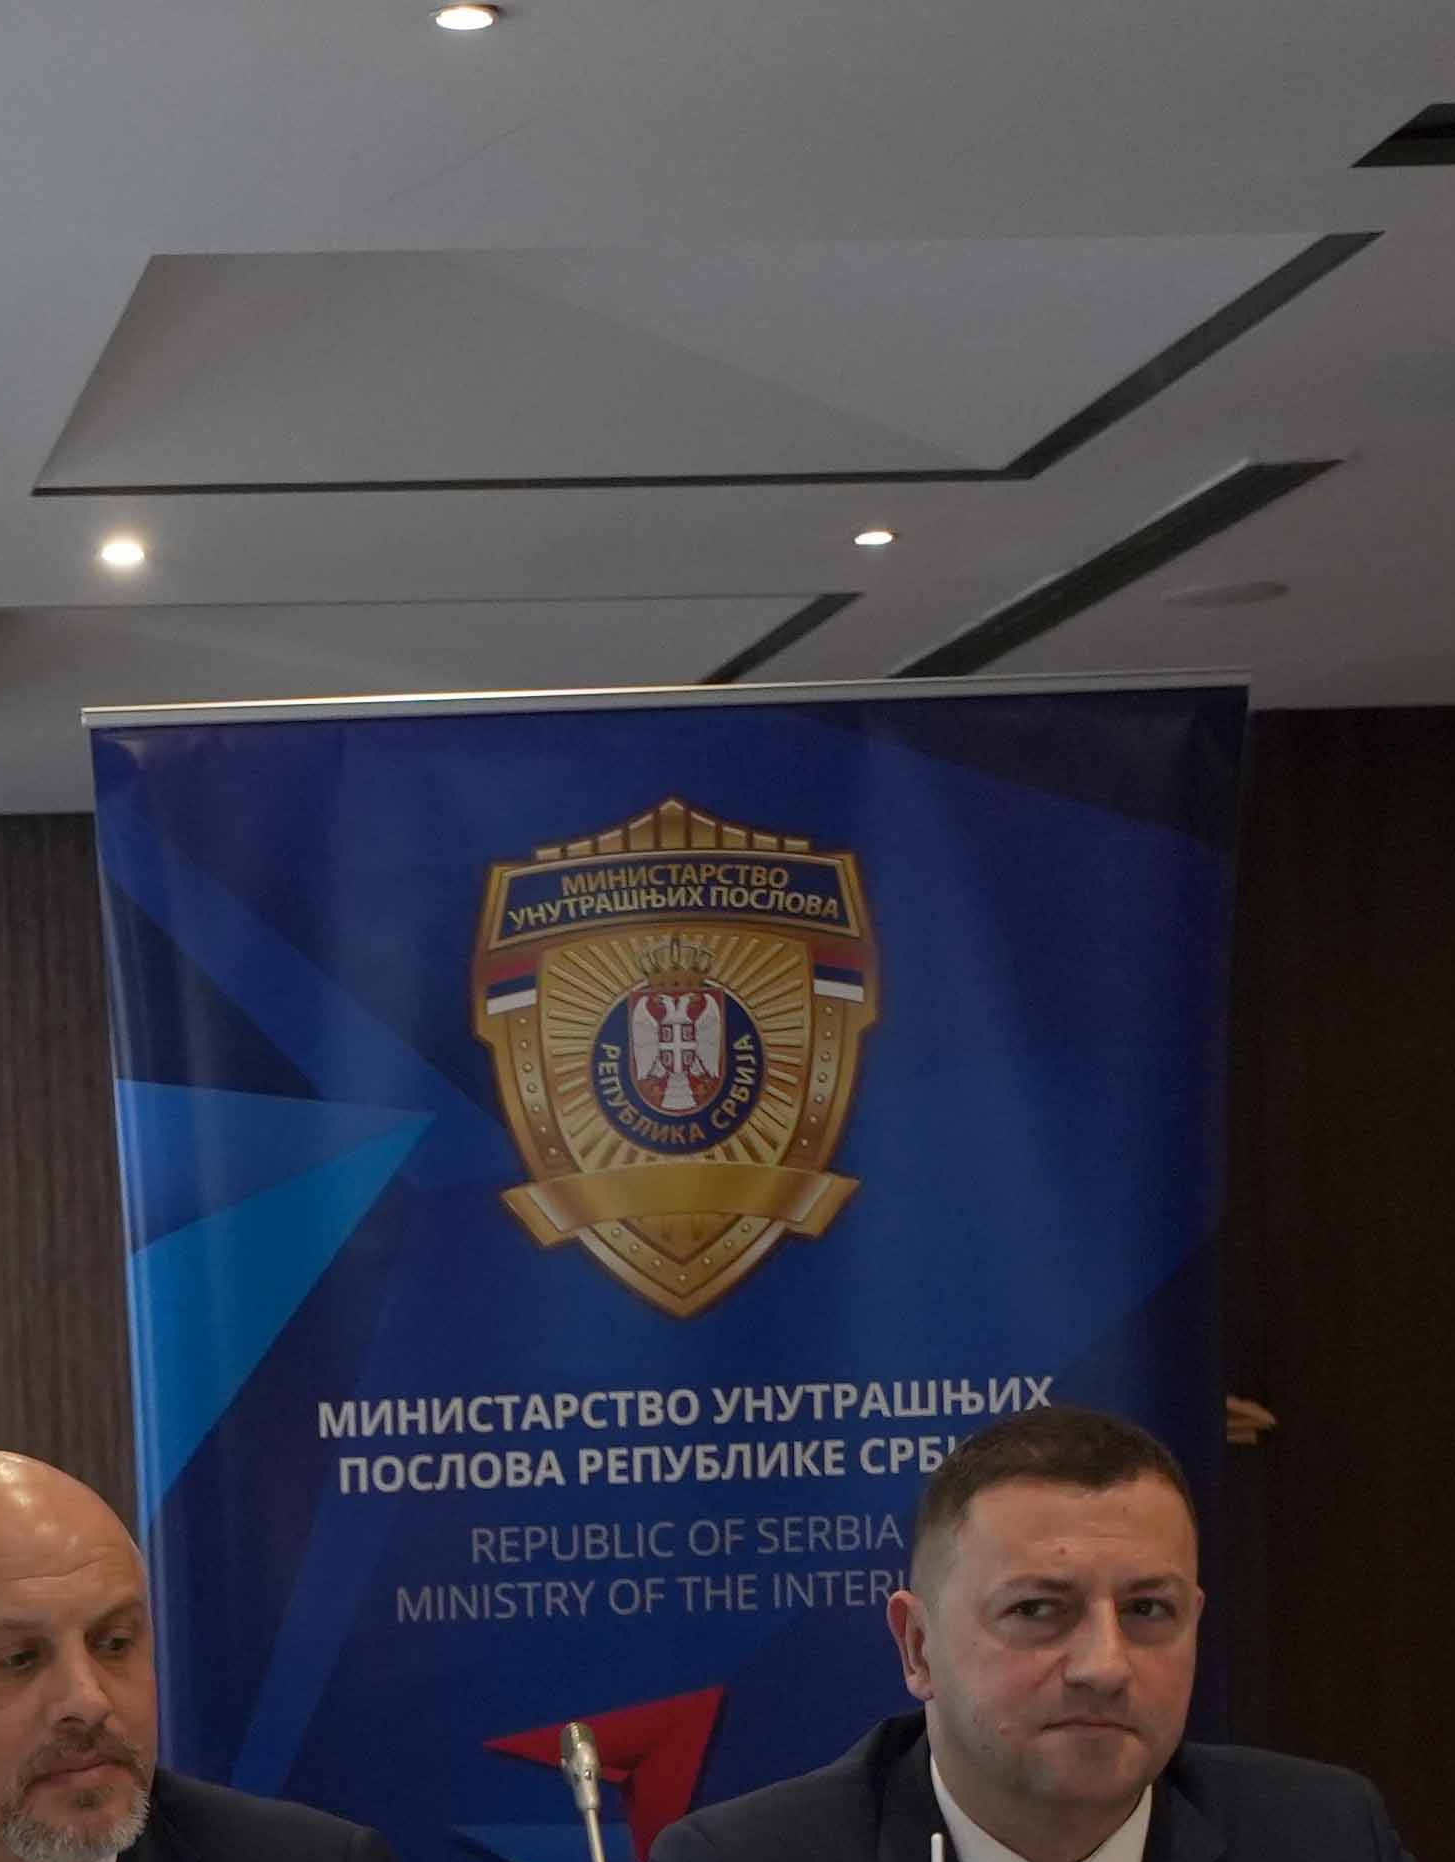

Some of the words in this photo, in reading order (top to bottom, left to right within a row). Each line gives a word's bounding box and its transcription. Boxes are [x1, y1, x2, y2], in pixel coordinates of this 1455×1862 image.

[561, 864, 788, 896] МИНИСТАРСТВО
[508, 886, 703, 930] УНУТРАШЊИХ
[710, 886, 839, 919] ПОСЛОВА
[597, 1043, 706, 1144] РЕПУБЛИКА
[710, 1033, 756, 1129] СРБИЈА
[318, 1388, 700, 1439] МИНИСТАРСТВО
[712, 1376, 1054, 1424] УНУТРАШЊИХ
[339, 1449, 566, 1494] ПОСЛОВА
[578, 1440, 846, 1486] РЕПУБЛИКЕ
[471, 1521, 675, 1564] REPUBLIC
[688, 1518, 744, 1556] OF
[756, 1514, 905, 1554] SERBIA
[396, 1580, 596, 1624] MINISTRY
[608, 1577, 666, 1615] OF
[677, 1573, 758, 1613] THE
